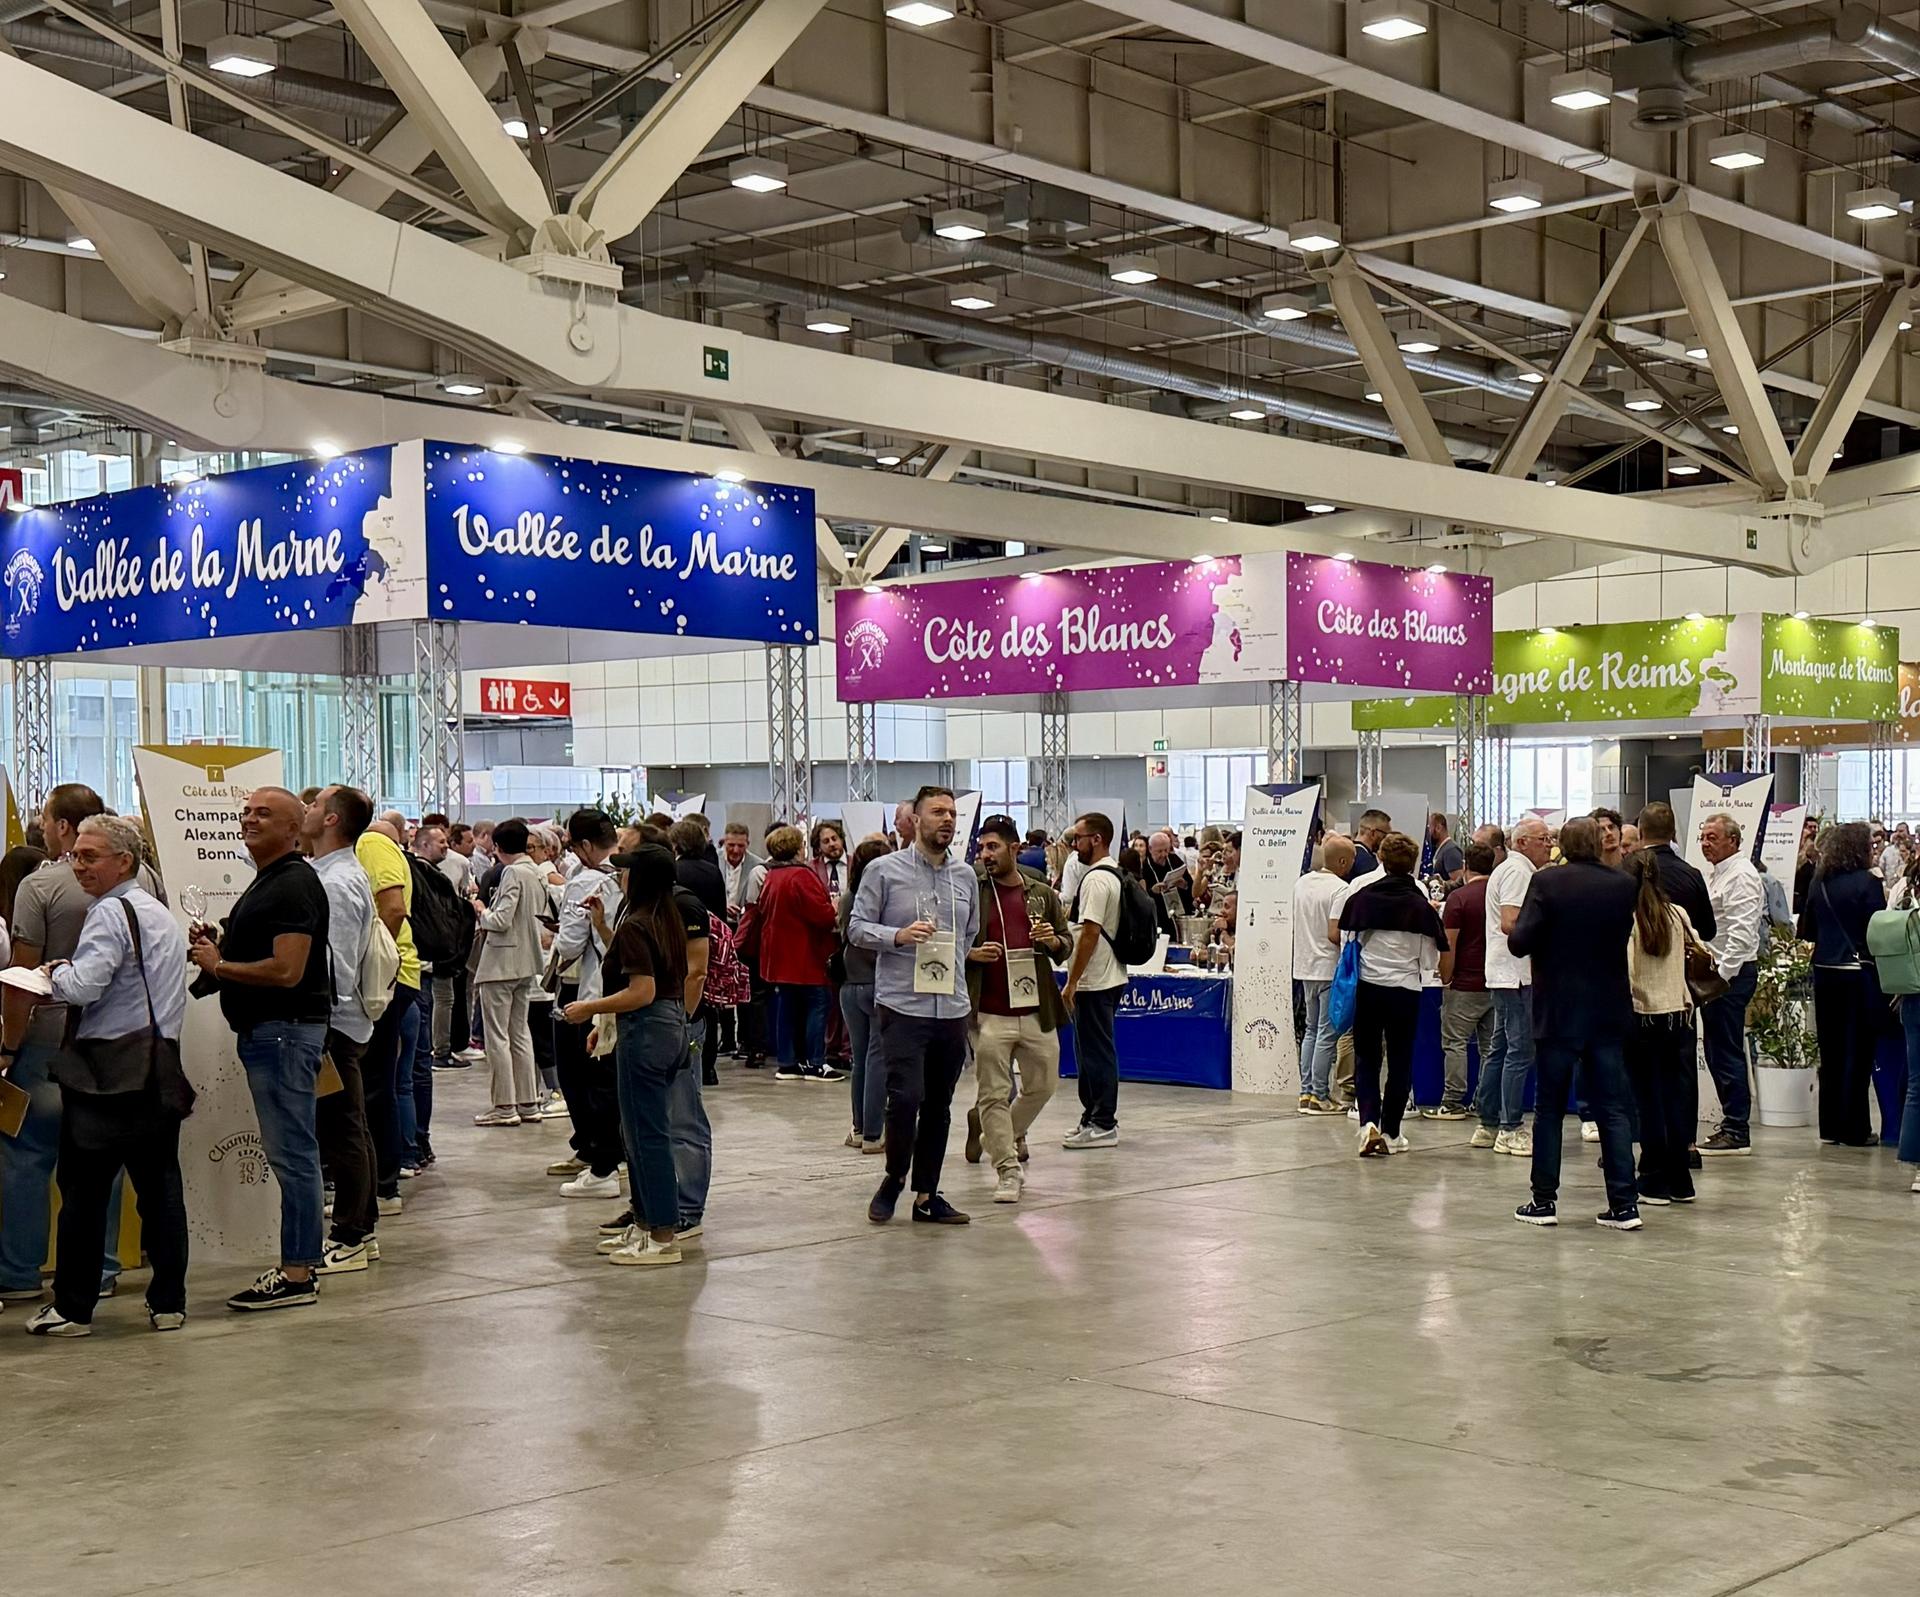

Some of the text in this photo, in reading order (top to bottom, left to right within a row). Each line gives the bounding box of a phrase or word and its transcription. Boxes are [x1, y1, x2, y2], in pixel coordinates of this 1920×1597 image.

[452, 504, 797, 581] Vallée de la Marne
[52, 518, 345, 612] Vallée de la Marne
[923, 604, 1176, 665] Côte des Blancs
[1316, 598, 1469, 647] Côte des Blancs
[1561, 658, 1593, 692] de
[1597, 651, 1696, 689] Reims
[1767, 649, 1895, 685] Montagne de Reims
[183, 784, 208, 798] Côte
[211, 786, 228, 797] des
[1283, 807, 1303, 816] Marne
[1252, 827, 1297, 837] Champagne
[1258, 838, 1287, 847] O. Belin
[197, 847, 244, 861] Bonn
[1132, 987, 1147, 1006] la
[1147, 989, 1195, 1011] Marne
